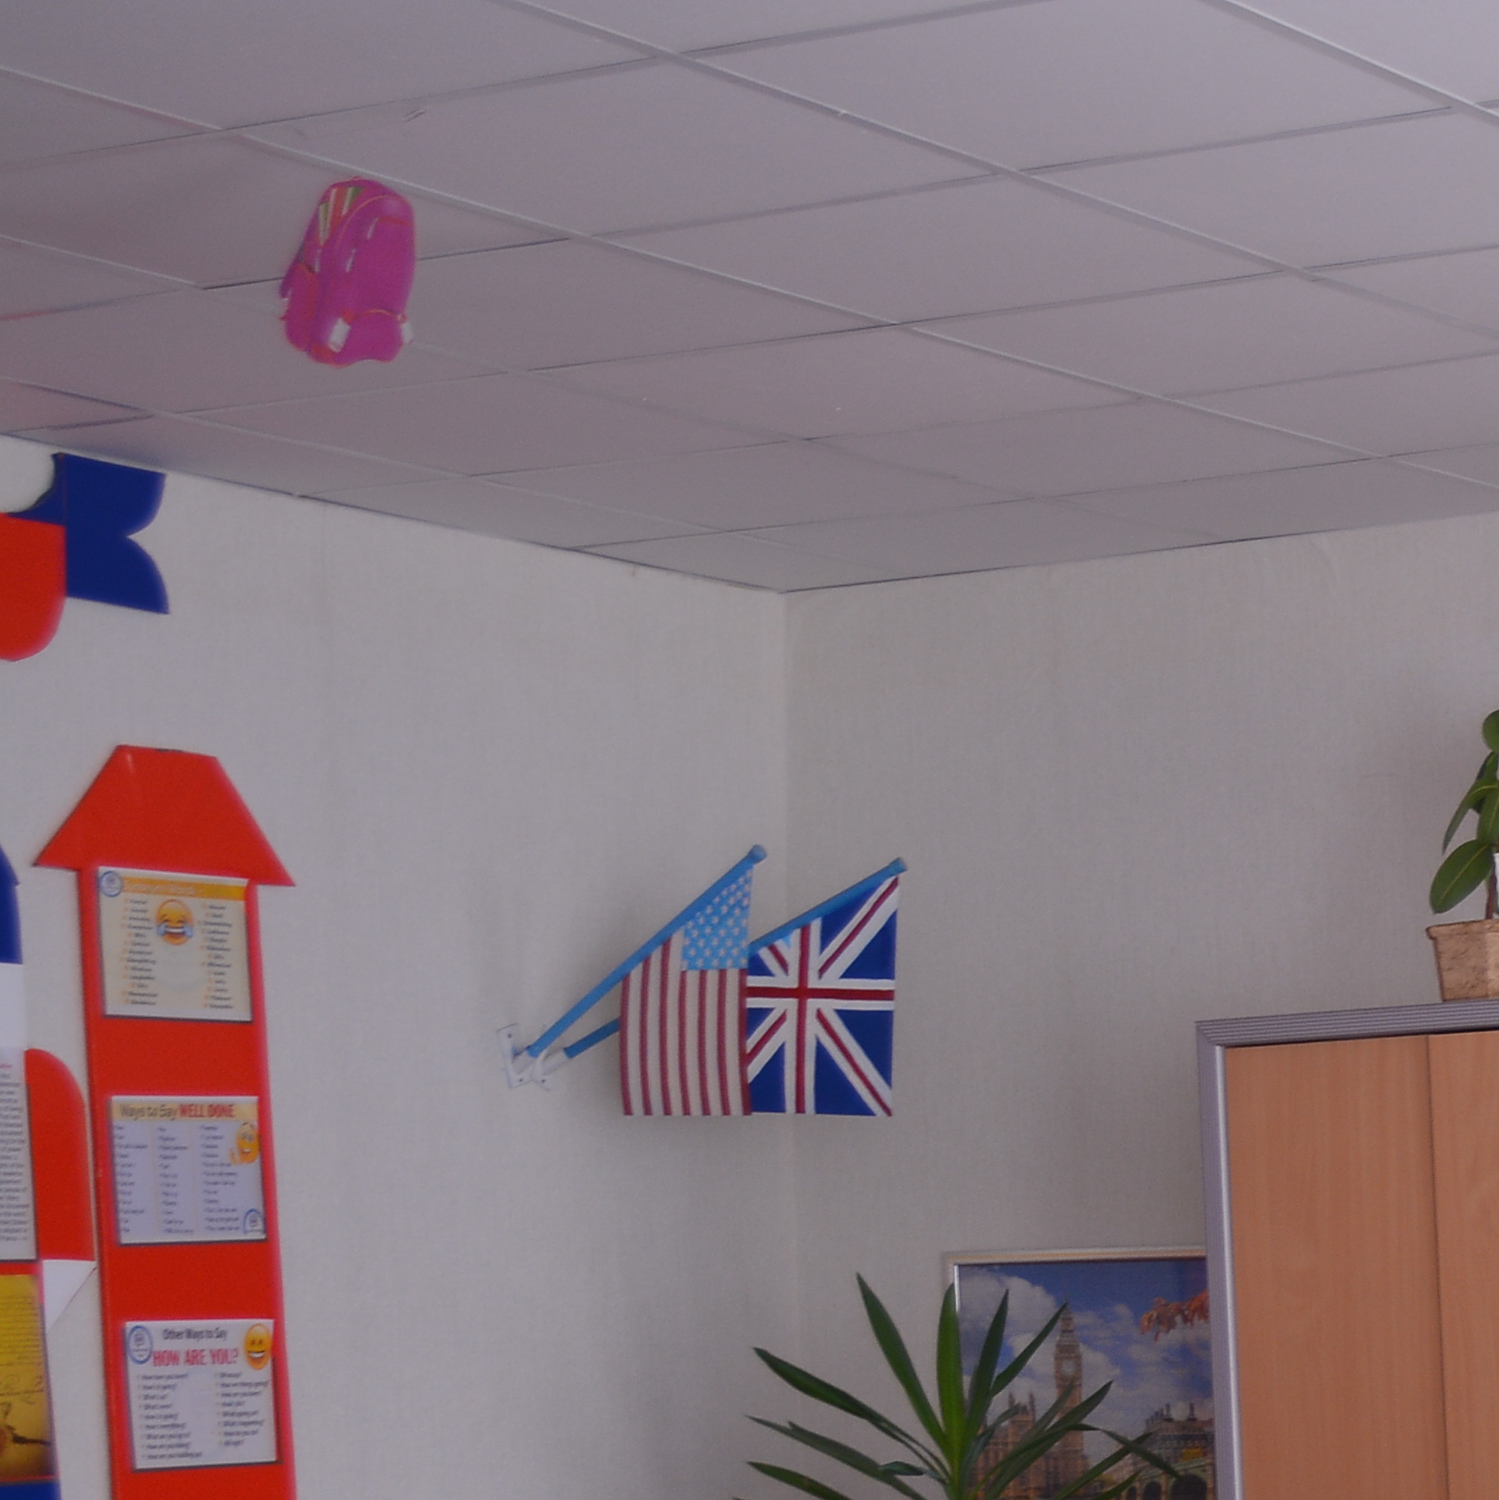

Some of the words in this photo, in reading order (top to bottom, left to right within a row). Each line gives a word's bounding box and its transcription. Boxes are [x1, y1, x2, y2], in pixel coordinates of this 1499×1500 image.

[179, 1103, 206, 1118] WELL
[207, 1103, 236, 1118] DONE
[153, 1349, 181, 1367] HOW
[185, 1348, 207, 1366] ARE
[210, 1347, 239, 1365] YOU?
